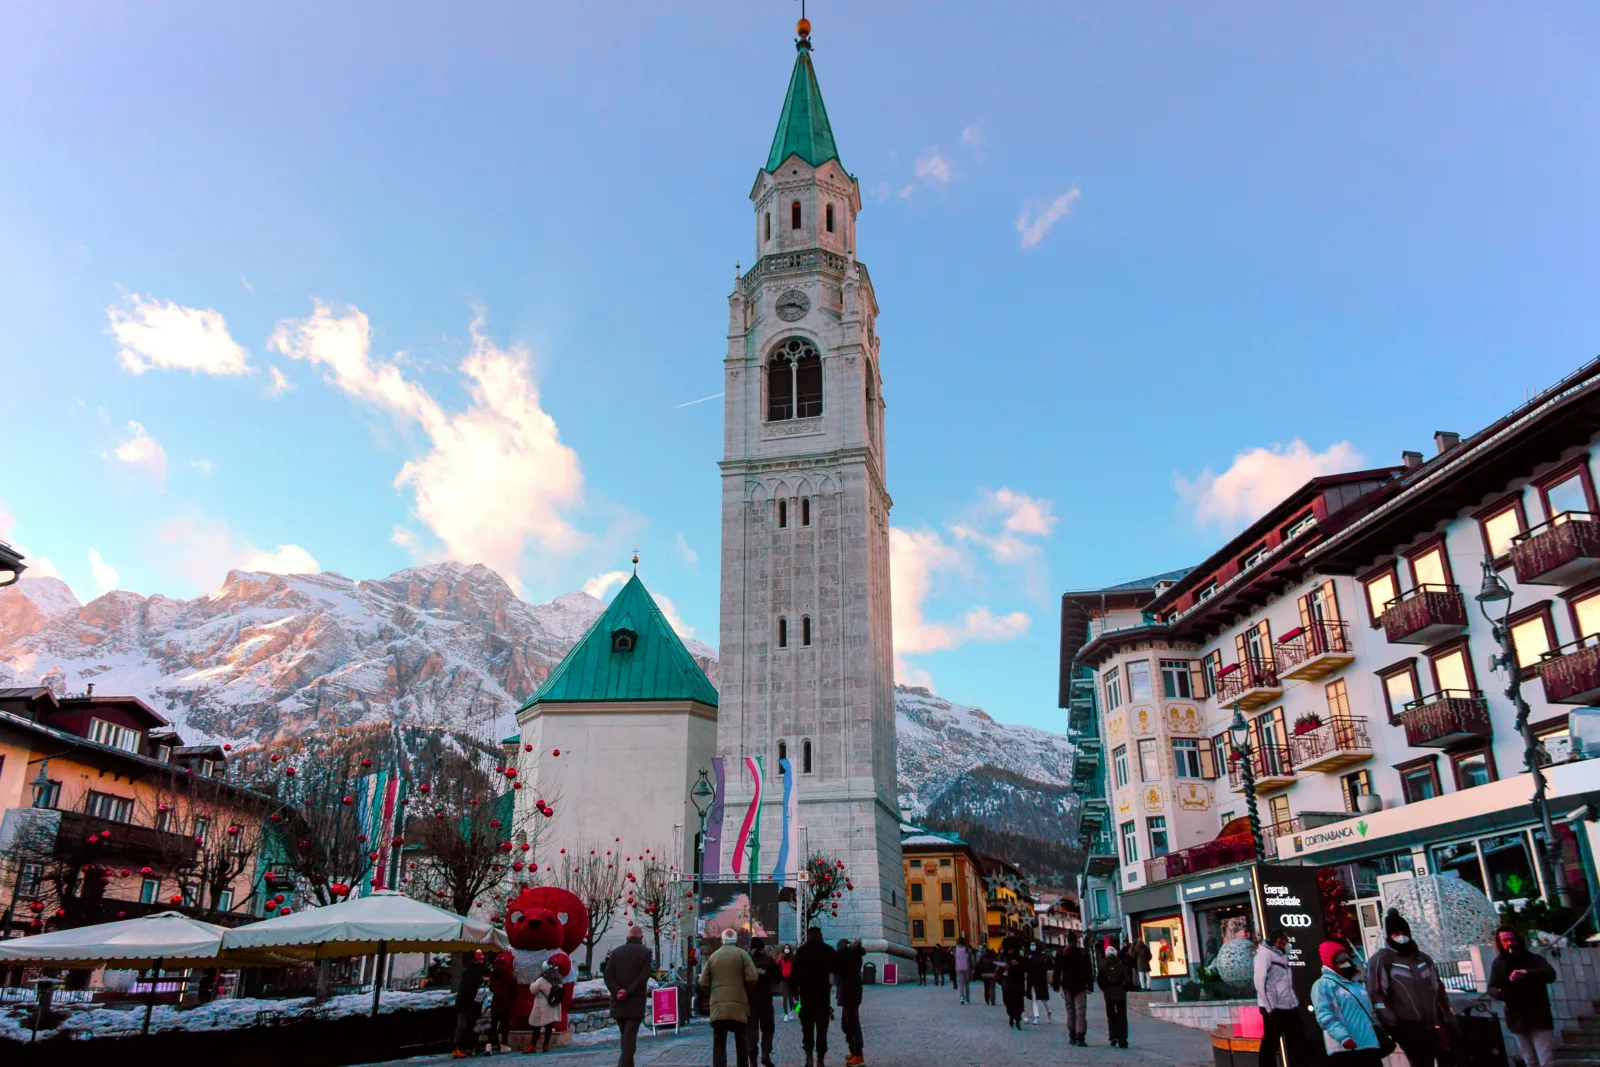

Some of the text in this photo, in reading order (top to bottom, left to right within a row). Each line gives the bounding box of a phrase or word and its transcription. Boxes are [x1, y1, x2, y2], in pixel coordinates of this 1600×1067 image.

[1305, 827, 1354, 846] CORTINABANCA
[1264, 884, 1288, 896] Energia
[1266, 896, 1301, 906] sostenibile
